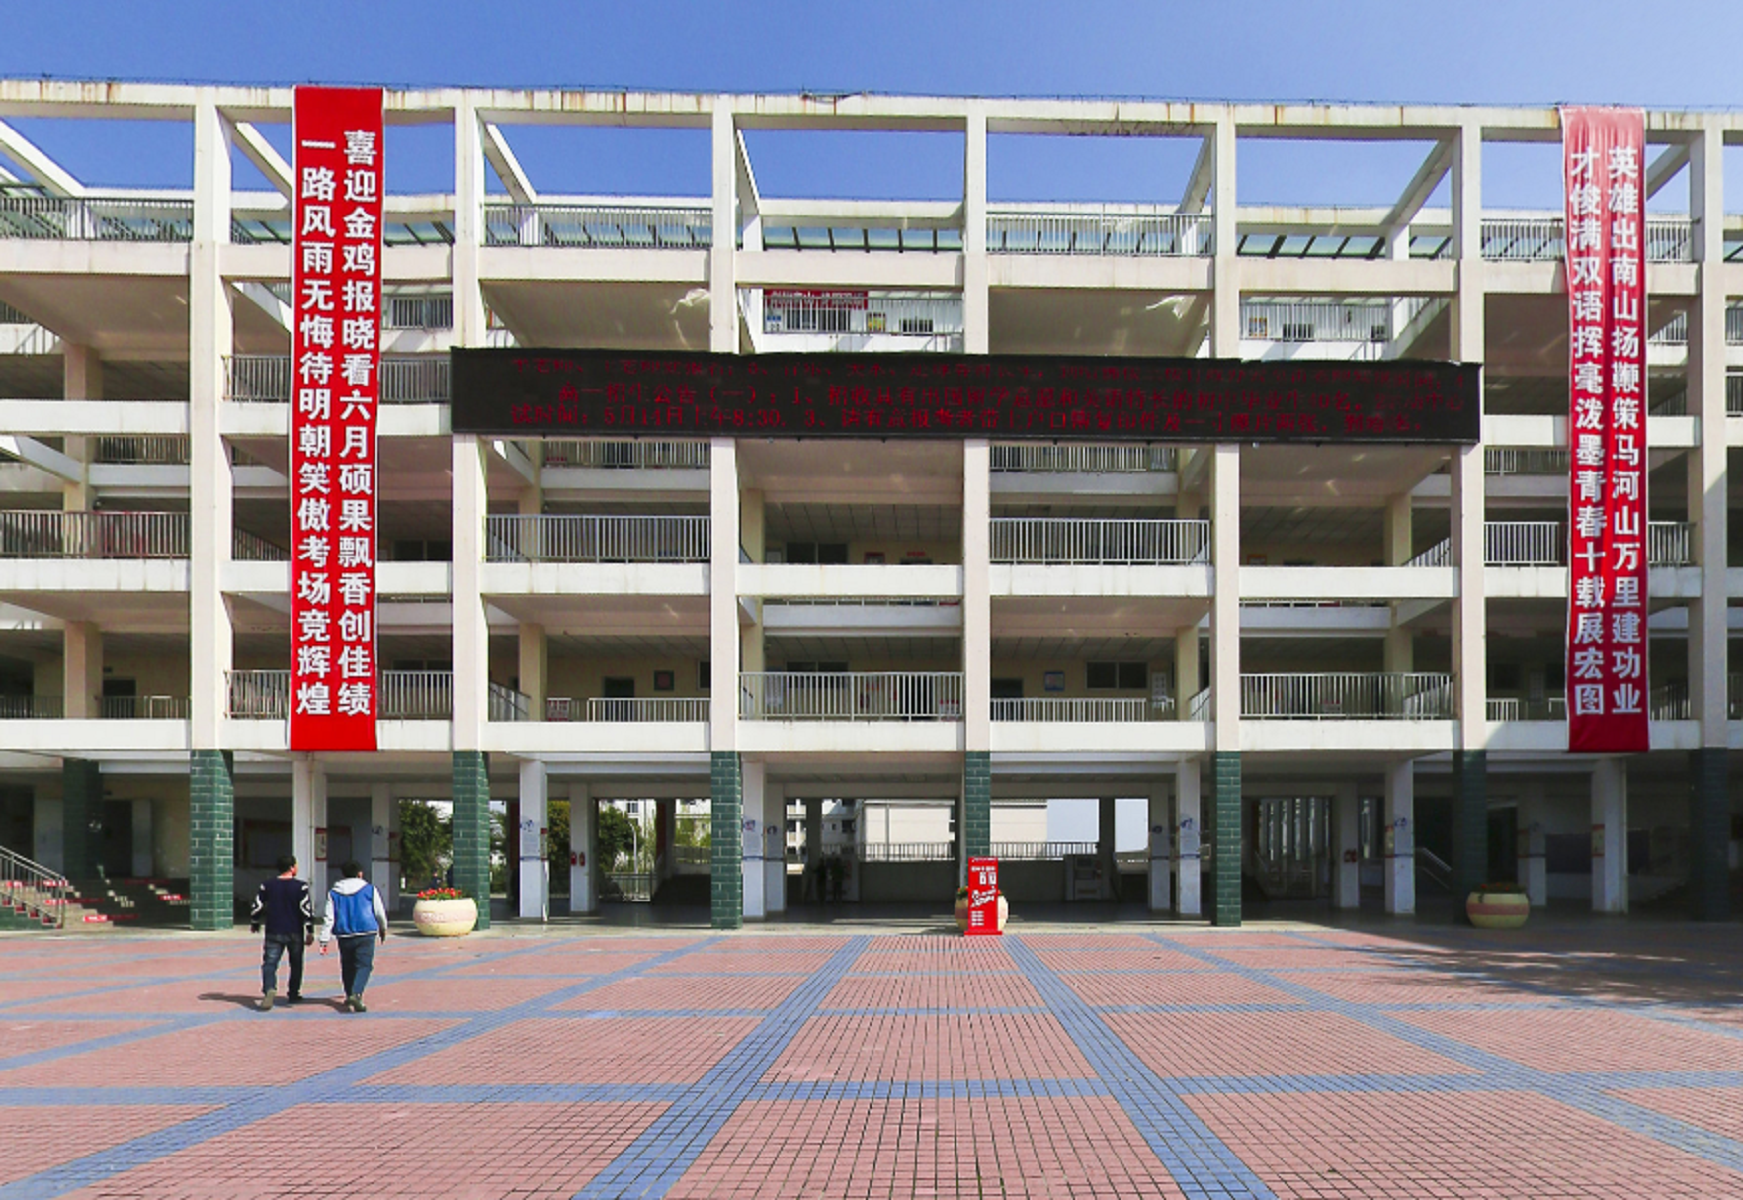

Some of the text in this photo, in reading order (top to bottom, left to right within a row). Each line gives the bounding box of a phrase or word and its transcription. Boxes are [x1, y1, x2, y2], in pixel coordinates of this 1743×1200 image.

[296, 139, 337, 716] 一路风雨无悔待明朝笑傲考场竞辉煌
[338, 129, 377, 717] 喜迎金鸡报晓看六月硕果飘香创佳绩
[1570, 146, 1607, 716] 才俊满双语挥毫泼墨青春十载展宏图
[1608, 145, 1642, 714] 英雄出南山扬鞭策马河山万里建功业
